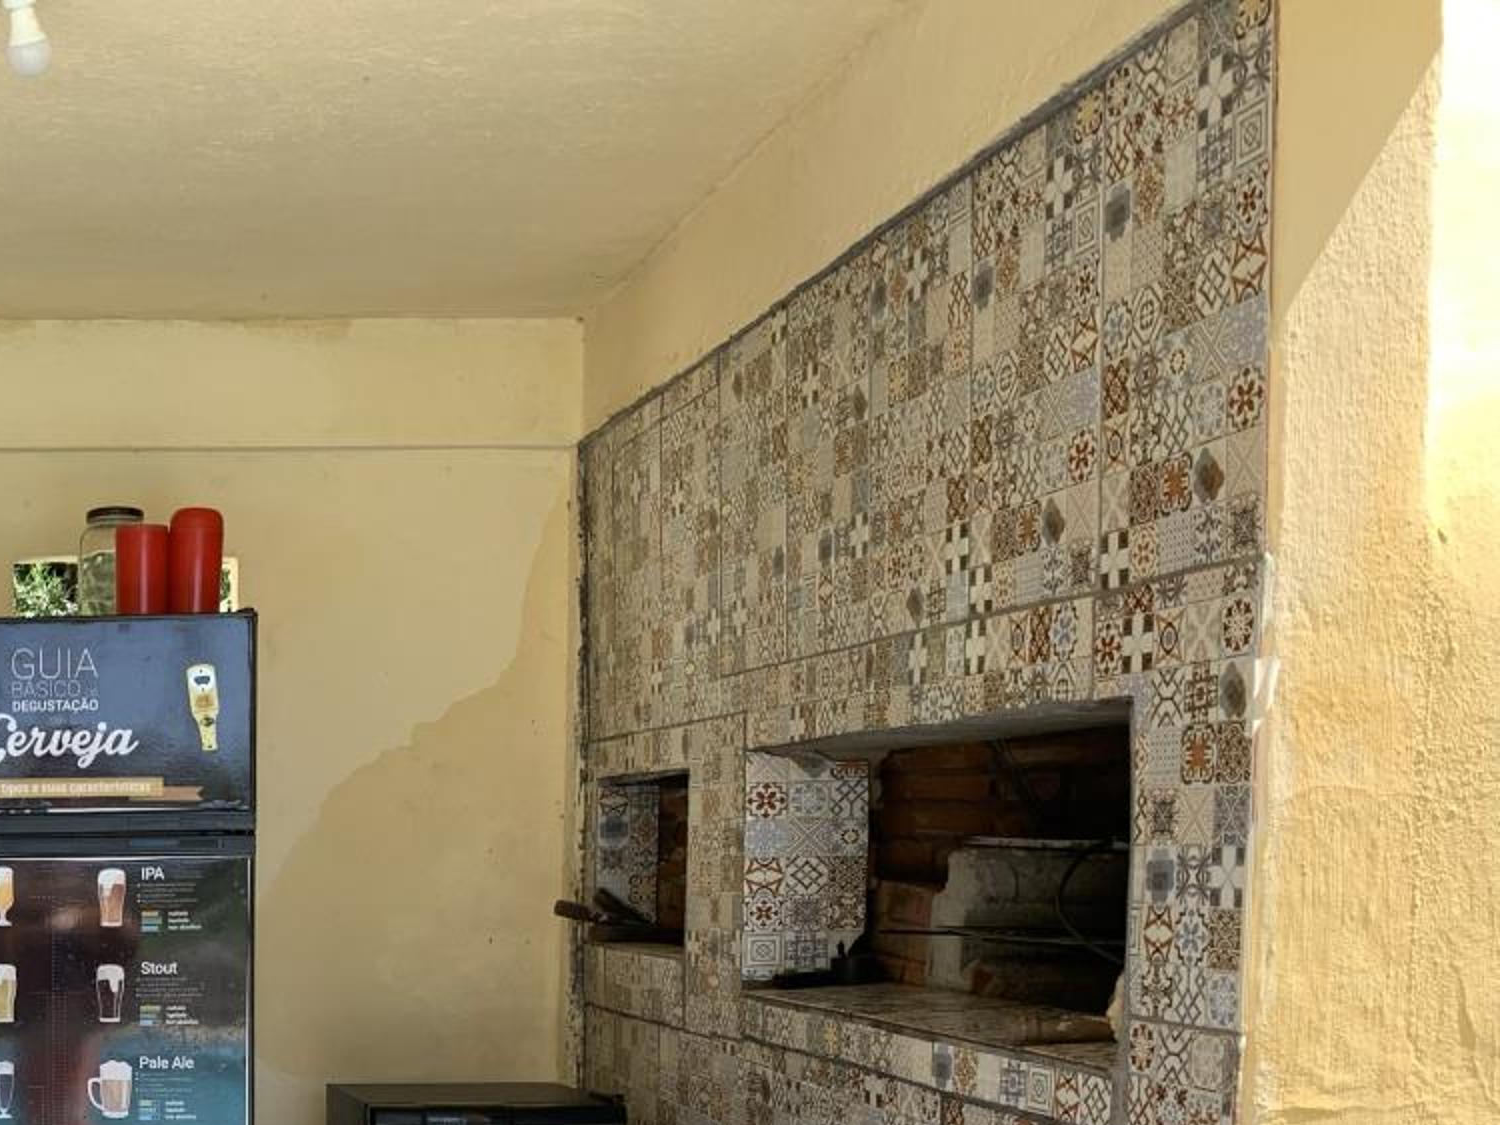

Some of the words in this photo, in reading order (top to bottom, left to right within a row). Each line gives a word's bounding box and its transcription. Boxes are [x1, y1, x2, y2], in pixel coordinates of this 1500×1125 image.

[11, 647, 98, 680] GUIA
[11, 698, 99, 714] DEGUSTAÇÃO
[141, 867, 165, 881] IPA
[141, 961, 178, 975] Stout
[139, 1056, 169, 1069] Pale
[171, 1056, 195, 1069] Ale
